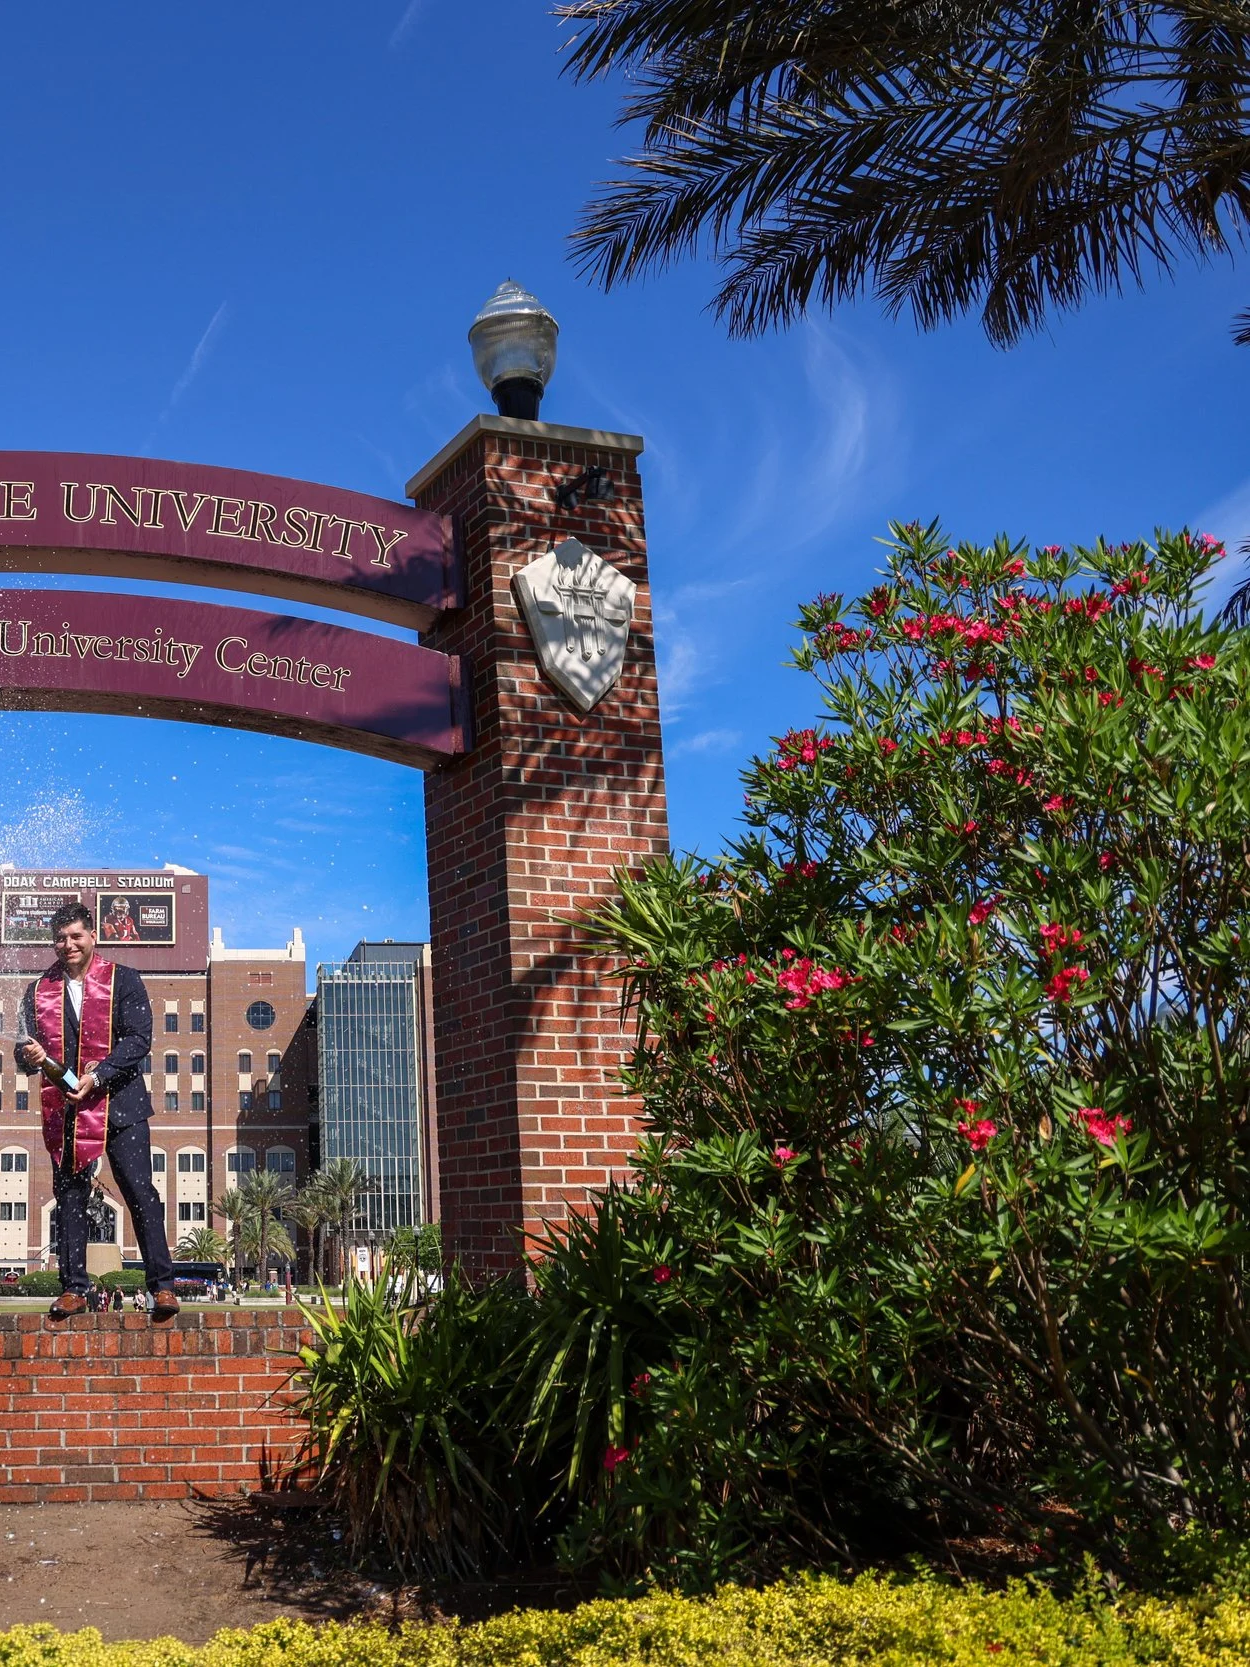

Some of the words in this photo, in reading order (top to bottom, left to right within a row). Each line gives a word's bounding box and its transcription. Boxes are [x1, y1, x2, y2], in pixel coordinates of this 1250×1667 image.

[59, 481, 409, 569] UNIVERSITY
[215, 636, 352, 692] Center
[3, 876, 37, 888] DOAK
[42, 876, 111, 889] CAMPBELL
[116, 876, 175, 889] STADIUM
